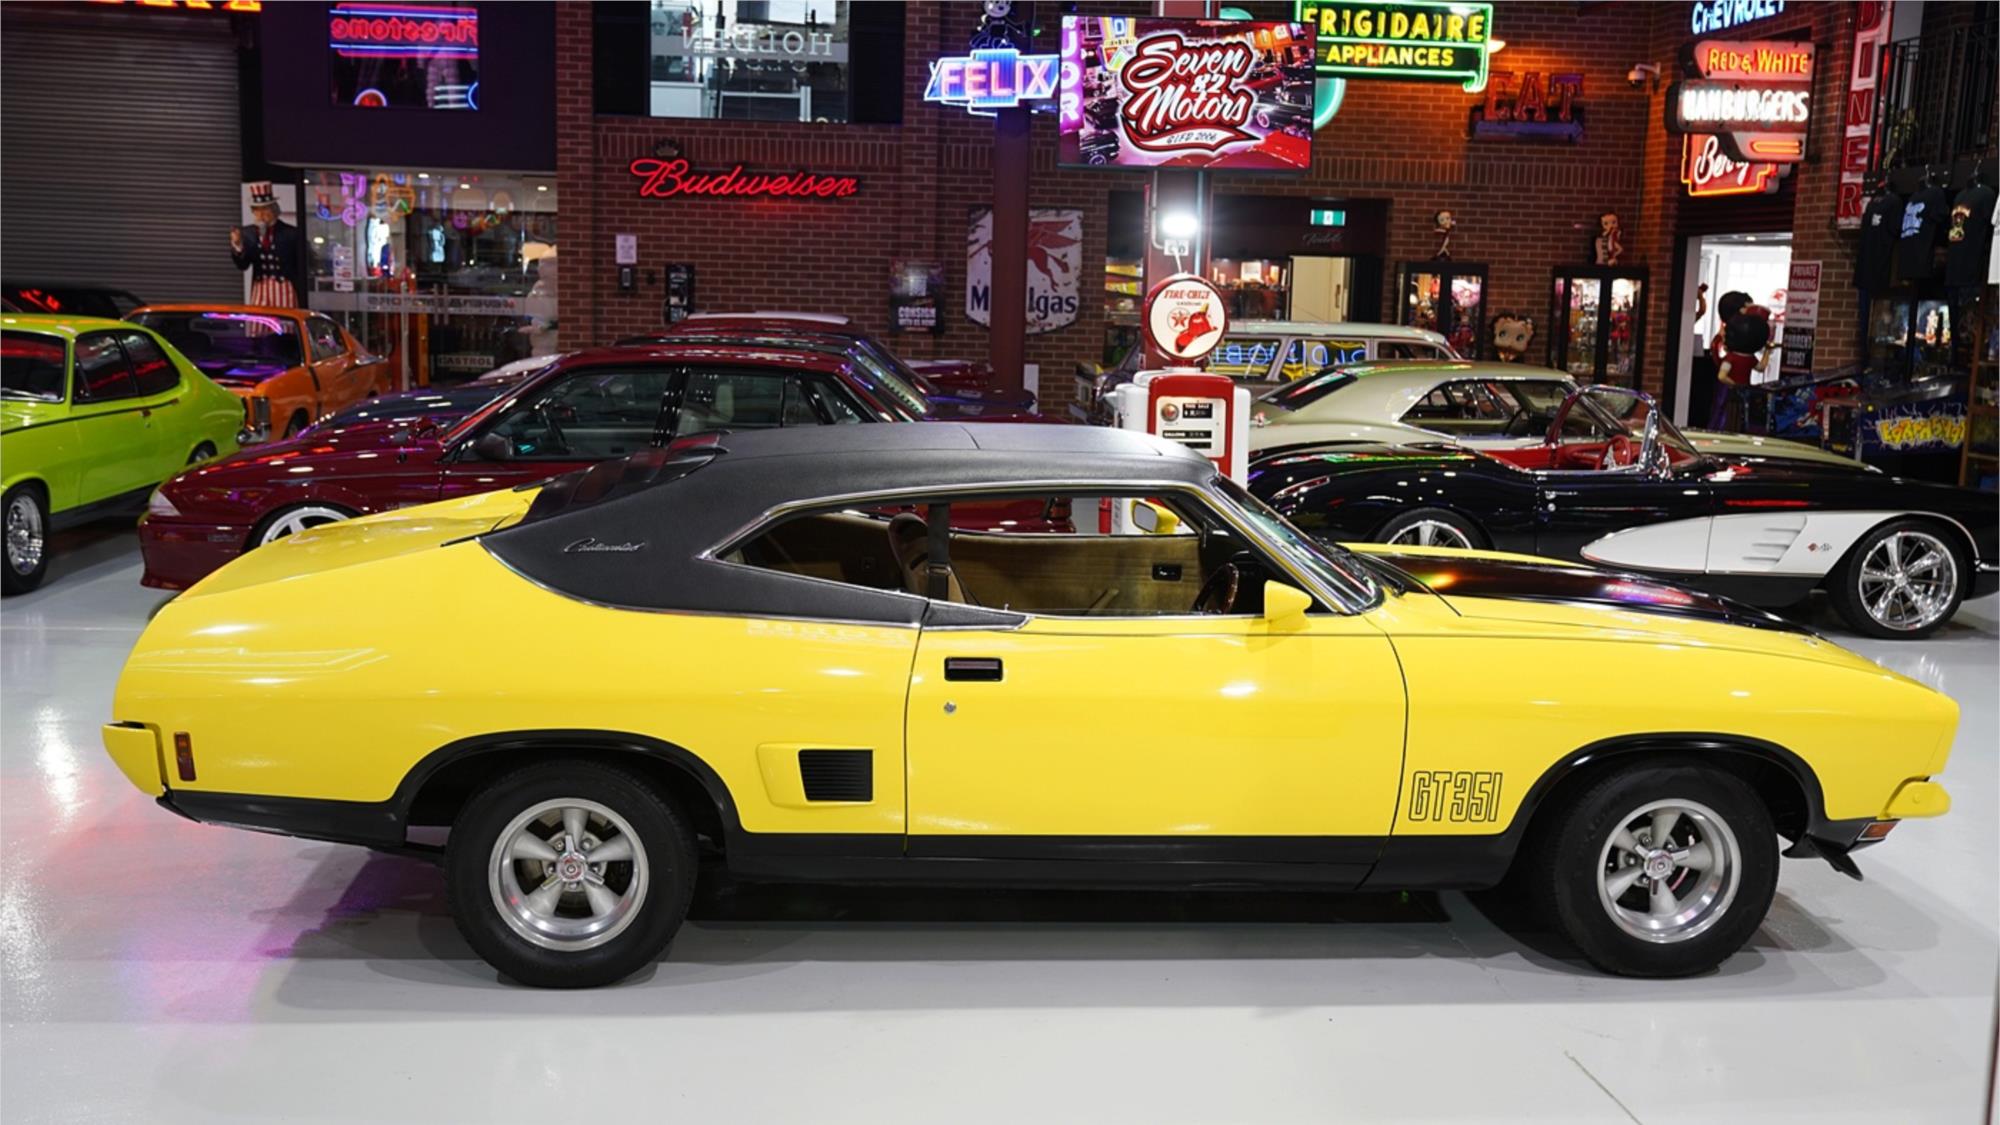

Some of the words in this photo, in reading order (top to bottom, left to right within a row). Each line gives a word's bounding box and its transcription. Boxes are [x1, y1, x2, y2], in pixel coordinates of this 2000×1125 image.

[1302, 7, 1485, 41] FRIGIDAIRE
[1692, 0, 1784, 35] CHEVROLET
[1126, 40, 1247, 89] Seven
[1326, 45, 1454, 66] APPLIANCES
[1709, 49, 1740, 70] RED
[1741, 55, 1752, 73] &
[1757, 49, 1809, 73] WHITE
[941, 61, 1050, 97] FELIX
[1191, 73, 1227, 93] 82
[1484, 71, 1585, 122] EAT
[1129, 84, 1248, 131] Motors
[1682, 89, 1810, 122] HAMBURGERS
[630, 158, 858, 197] Budweiser
